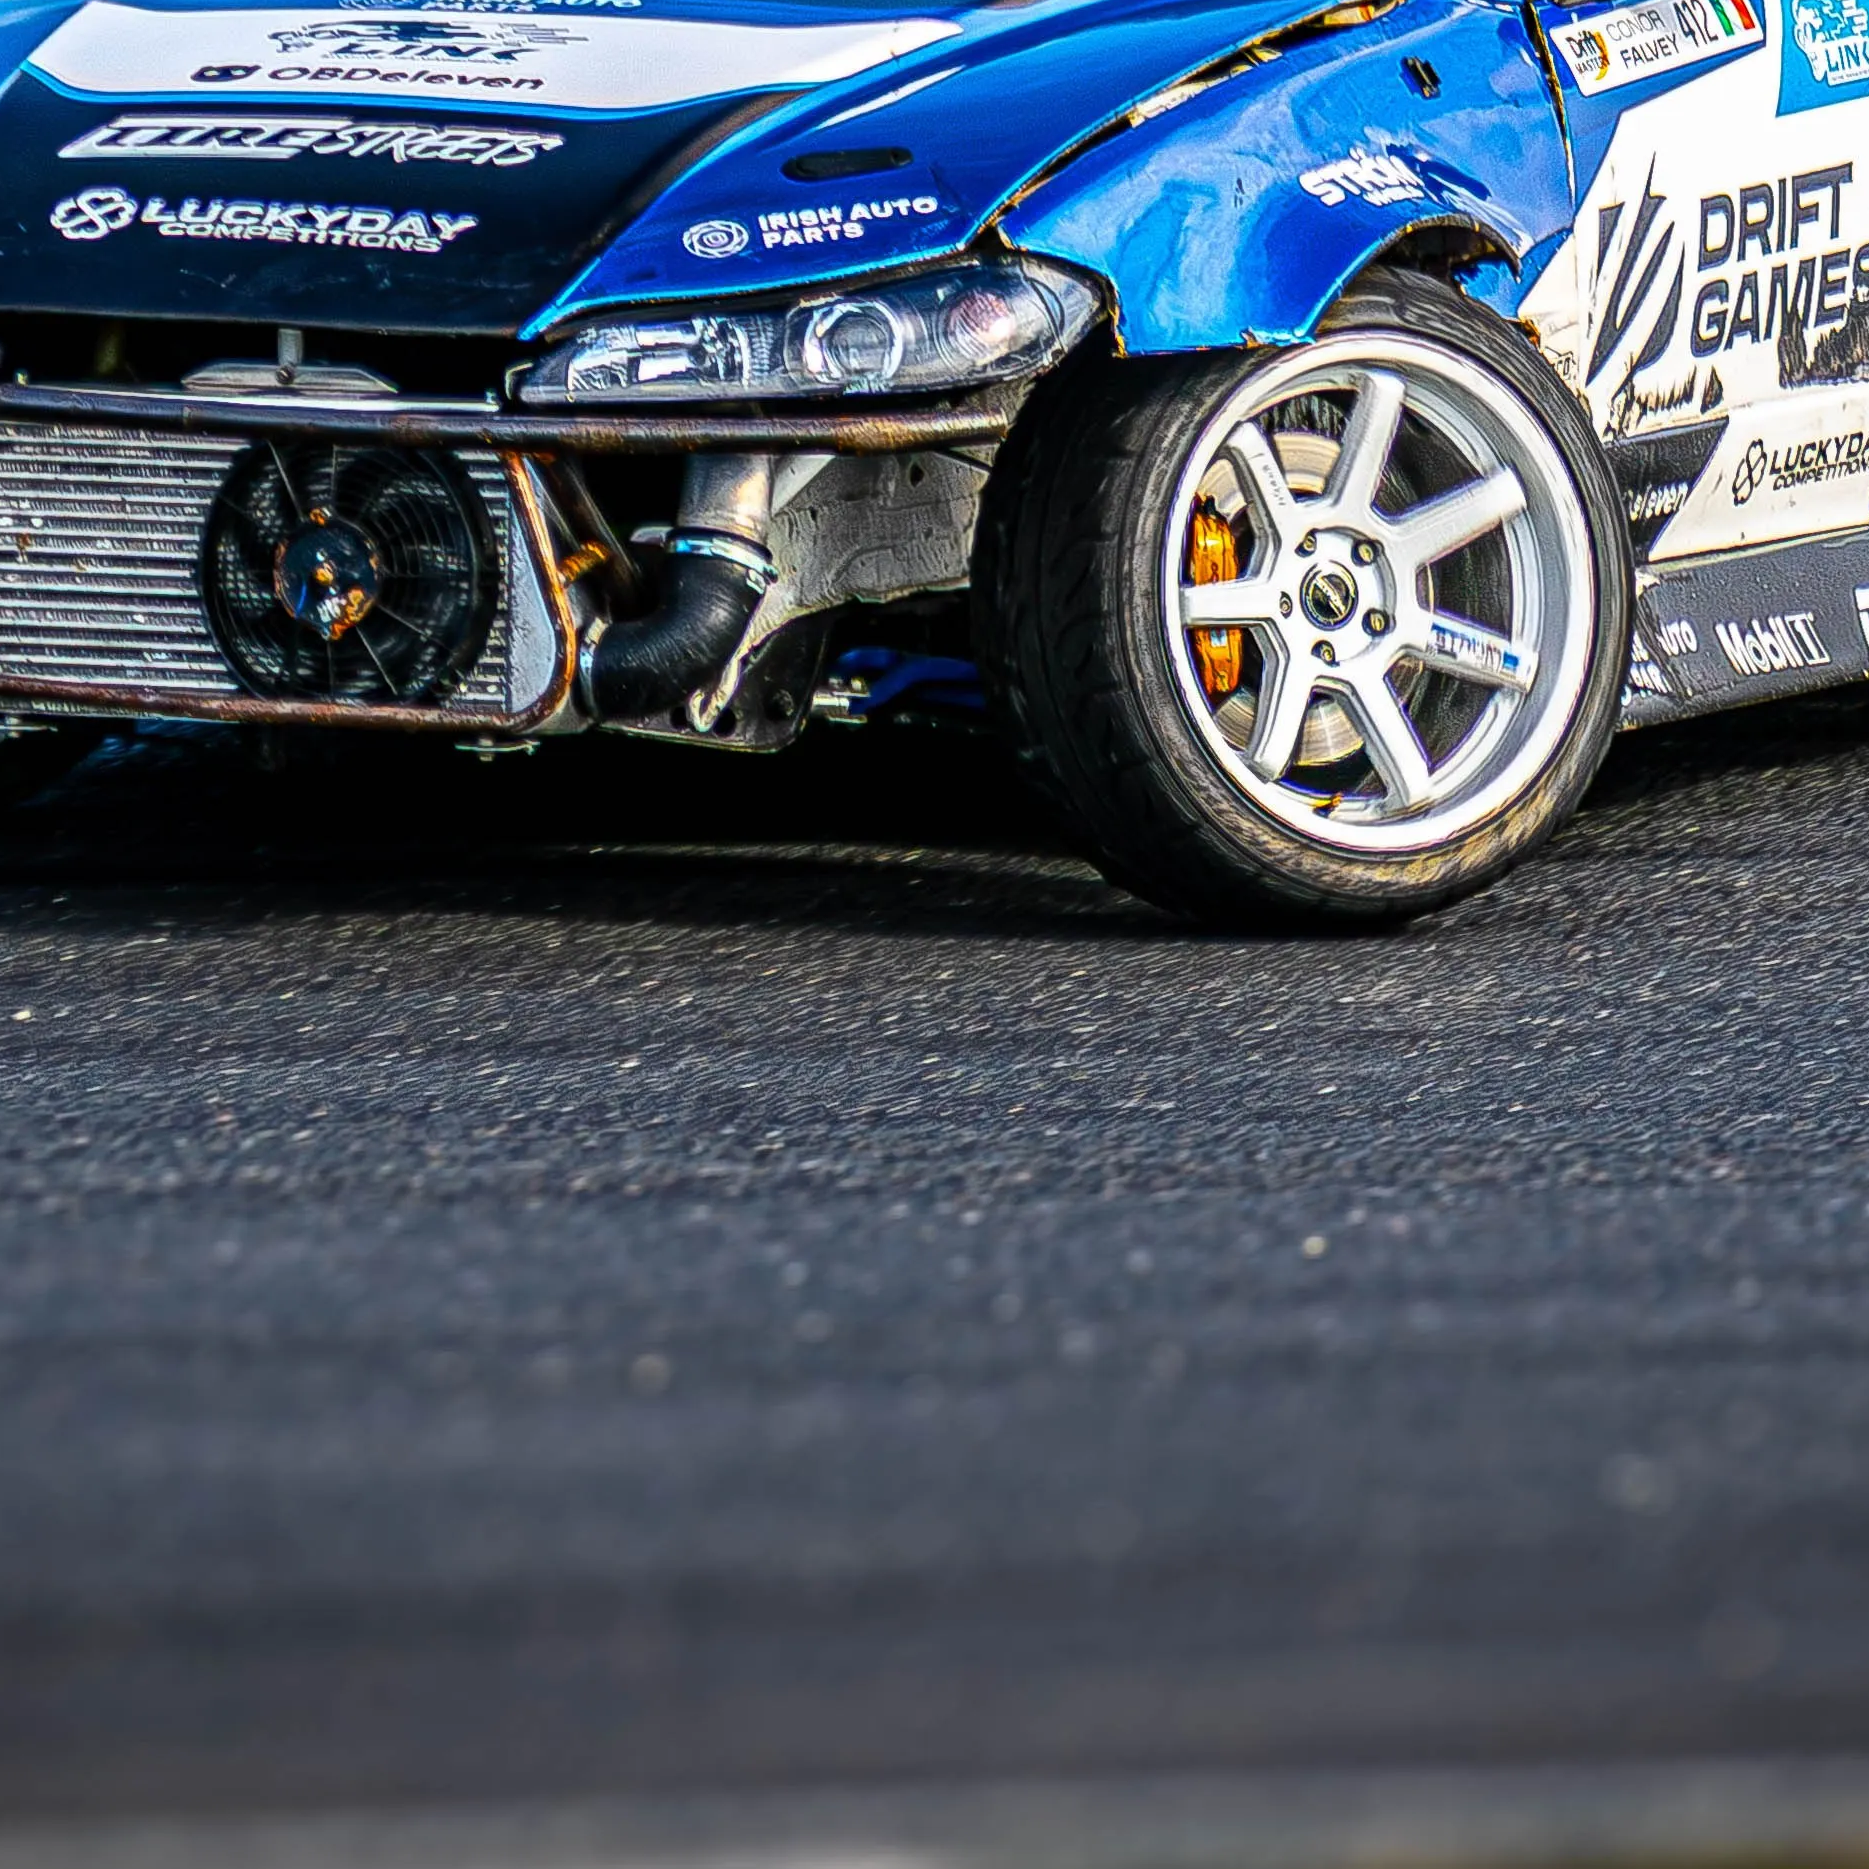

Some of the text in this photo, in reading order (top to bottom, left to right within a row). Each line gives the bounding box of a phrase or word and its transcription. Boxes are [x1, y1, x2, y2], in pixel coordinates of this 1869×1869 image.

[1605, 10, 1666, 41] CONOR
[1620, 32, 1681, 69] FALVEY
[268, 66, 545, 90] OBDeleven
[139, 197, 478, 241] LUCKYDAY
[758, 196, 938, 231] IRISH AUTO
[1697, 161, 1853, 272] DRIFT
[158, 222, 443, 253] COMPETITIONS
[763, 222, 865, 248] PARTS
[1715, 615, 1804, 675] Mobil
